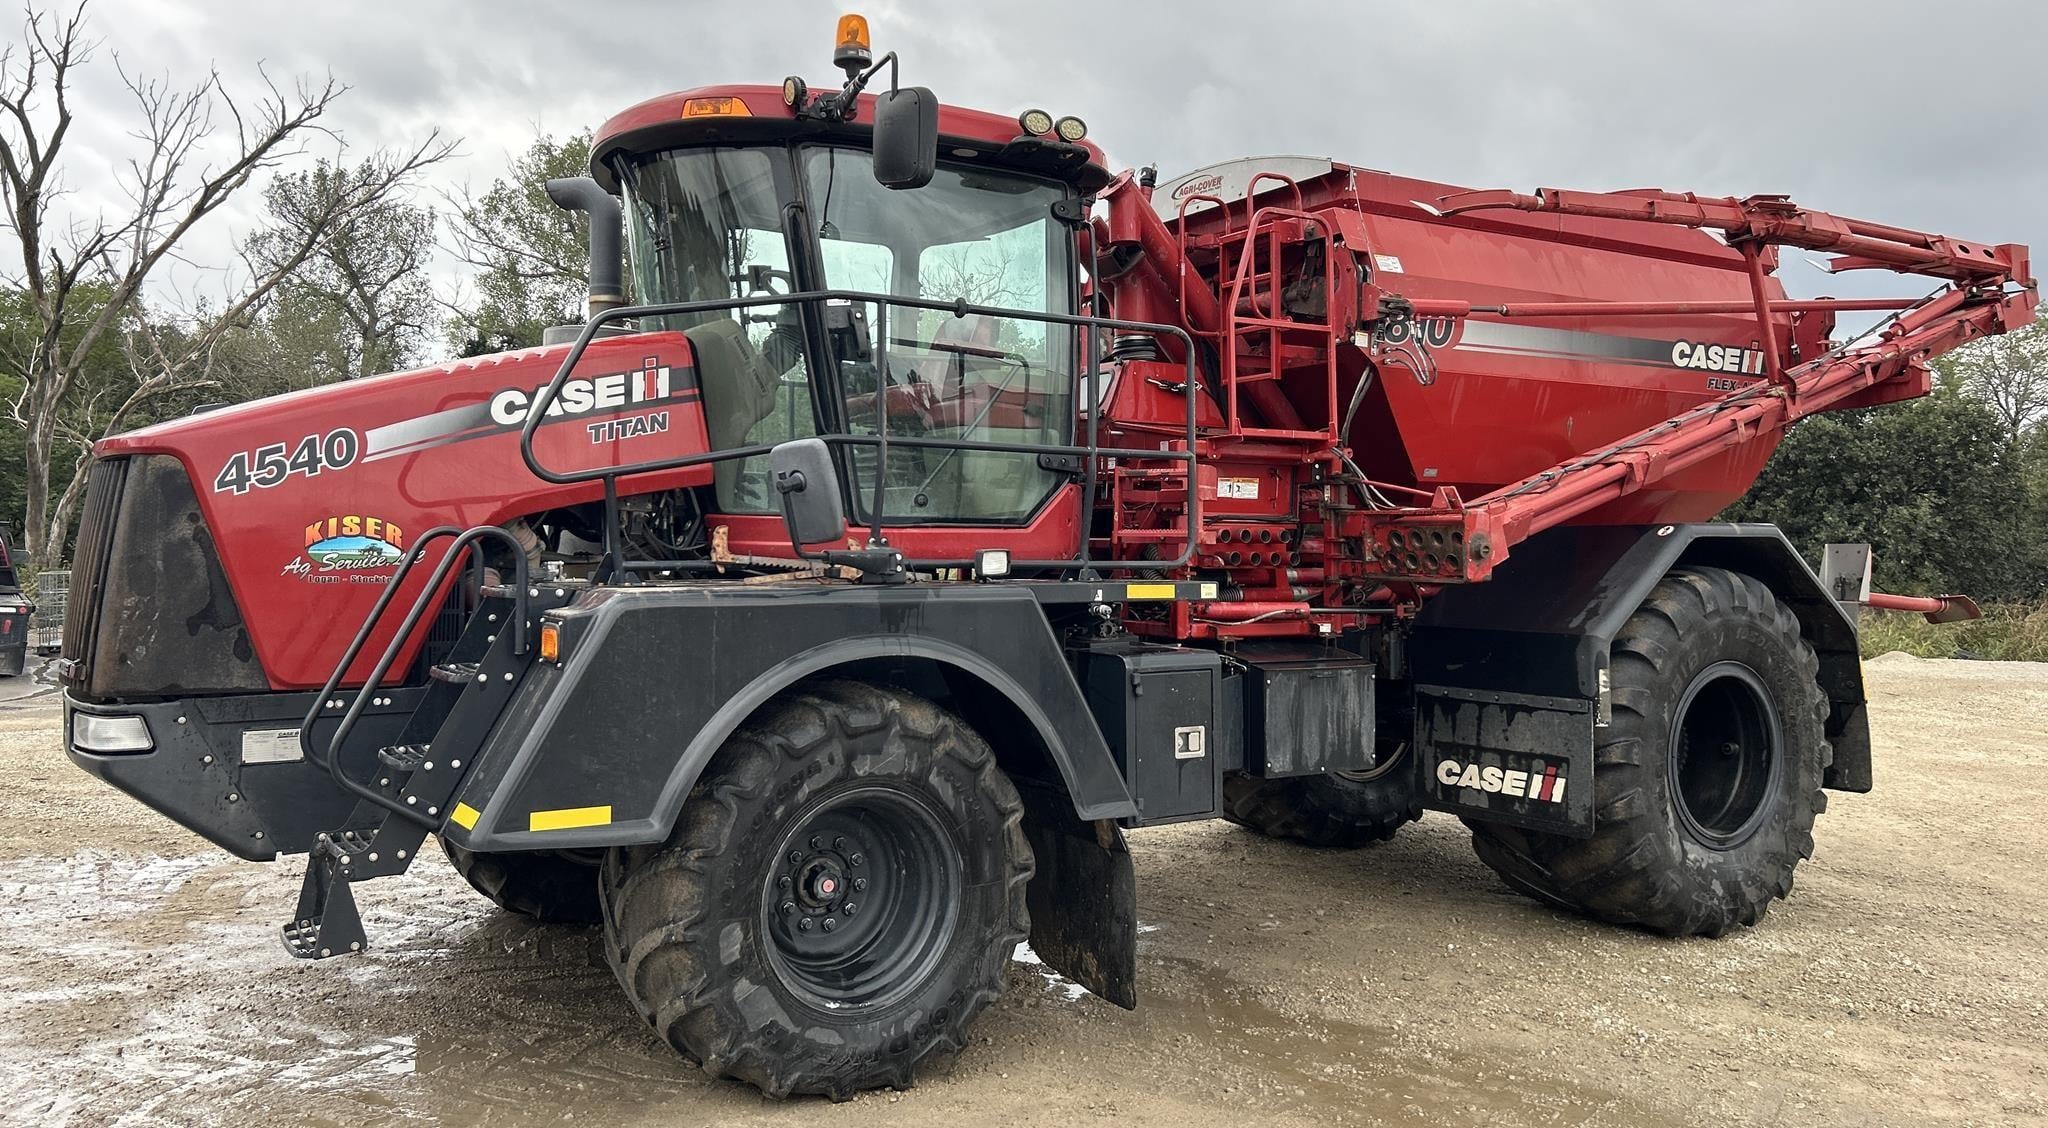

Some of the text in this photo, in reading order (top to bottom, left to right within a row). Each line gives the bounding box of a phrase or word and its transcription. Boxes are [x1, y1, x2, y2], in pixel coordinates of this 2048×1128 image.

[1178, 176, 1222, 197] AGRI-COVER
[1671, 341, 1741, 372] CASE
[489, 373, 625, 425] CASE
[587, 411, 669, 444] TITAN
[214, 427, 359, 496] 4540
[304, 514, 403, 549] KISER
[281, 556, 313, 580] Ag
[308, 574, 340, 584] Logan
[1436, 759, 1528, 797] CASE
